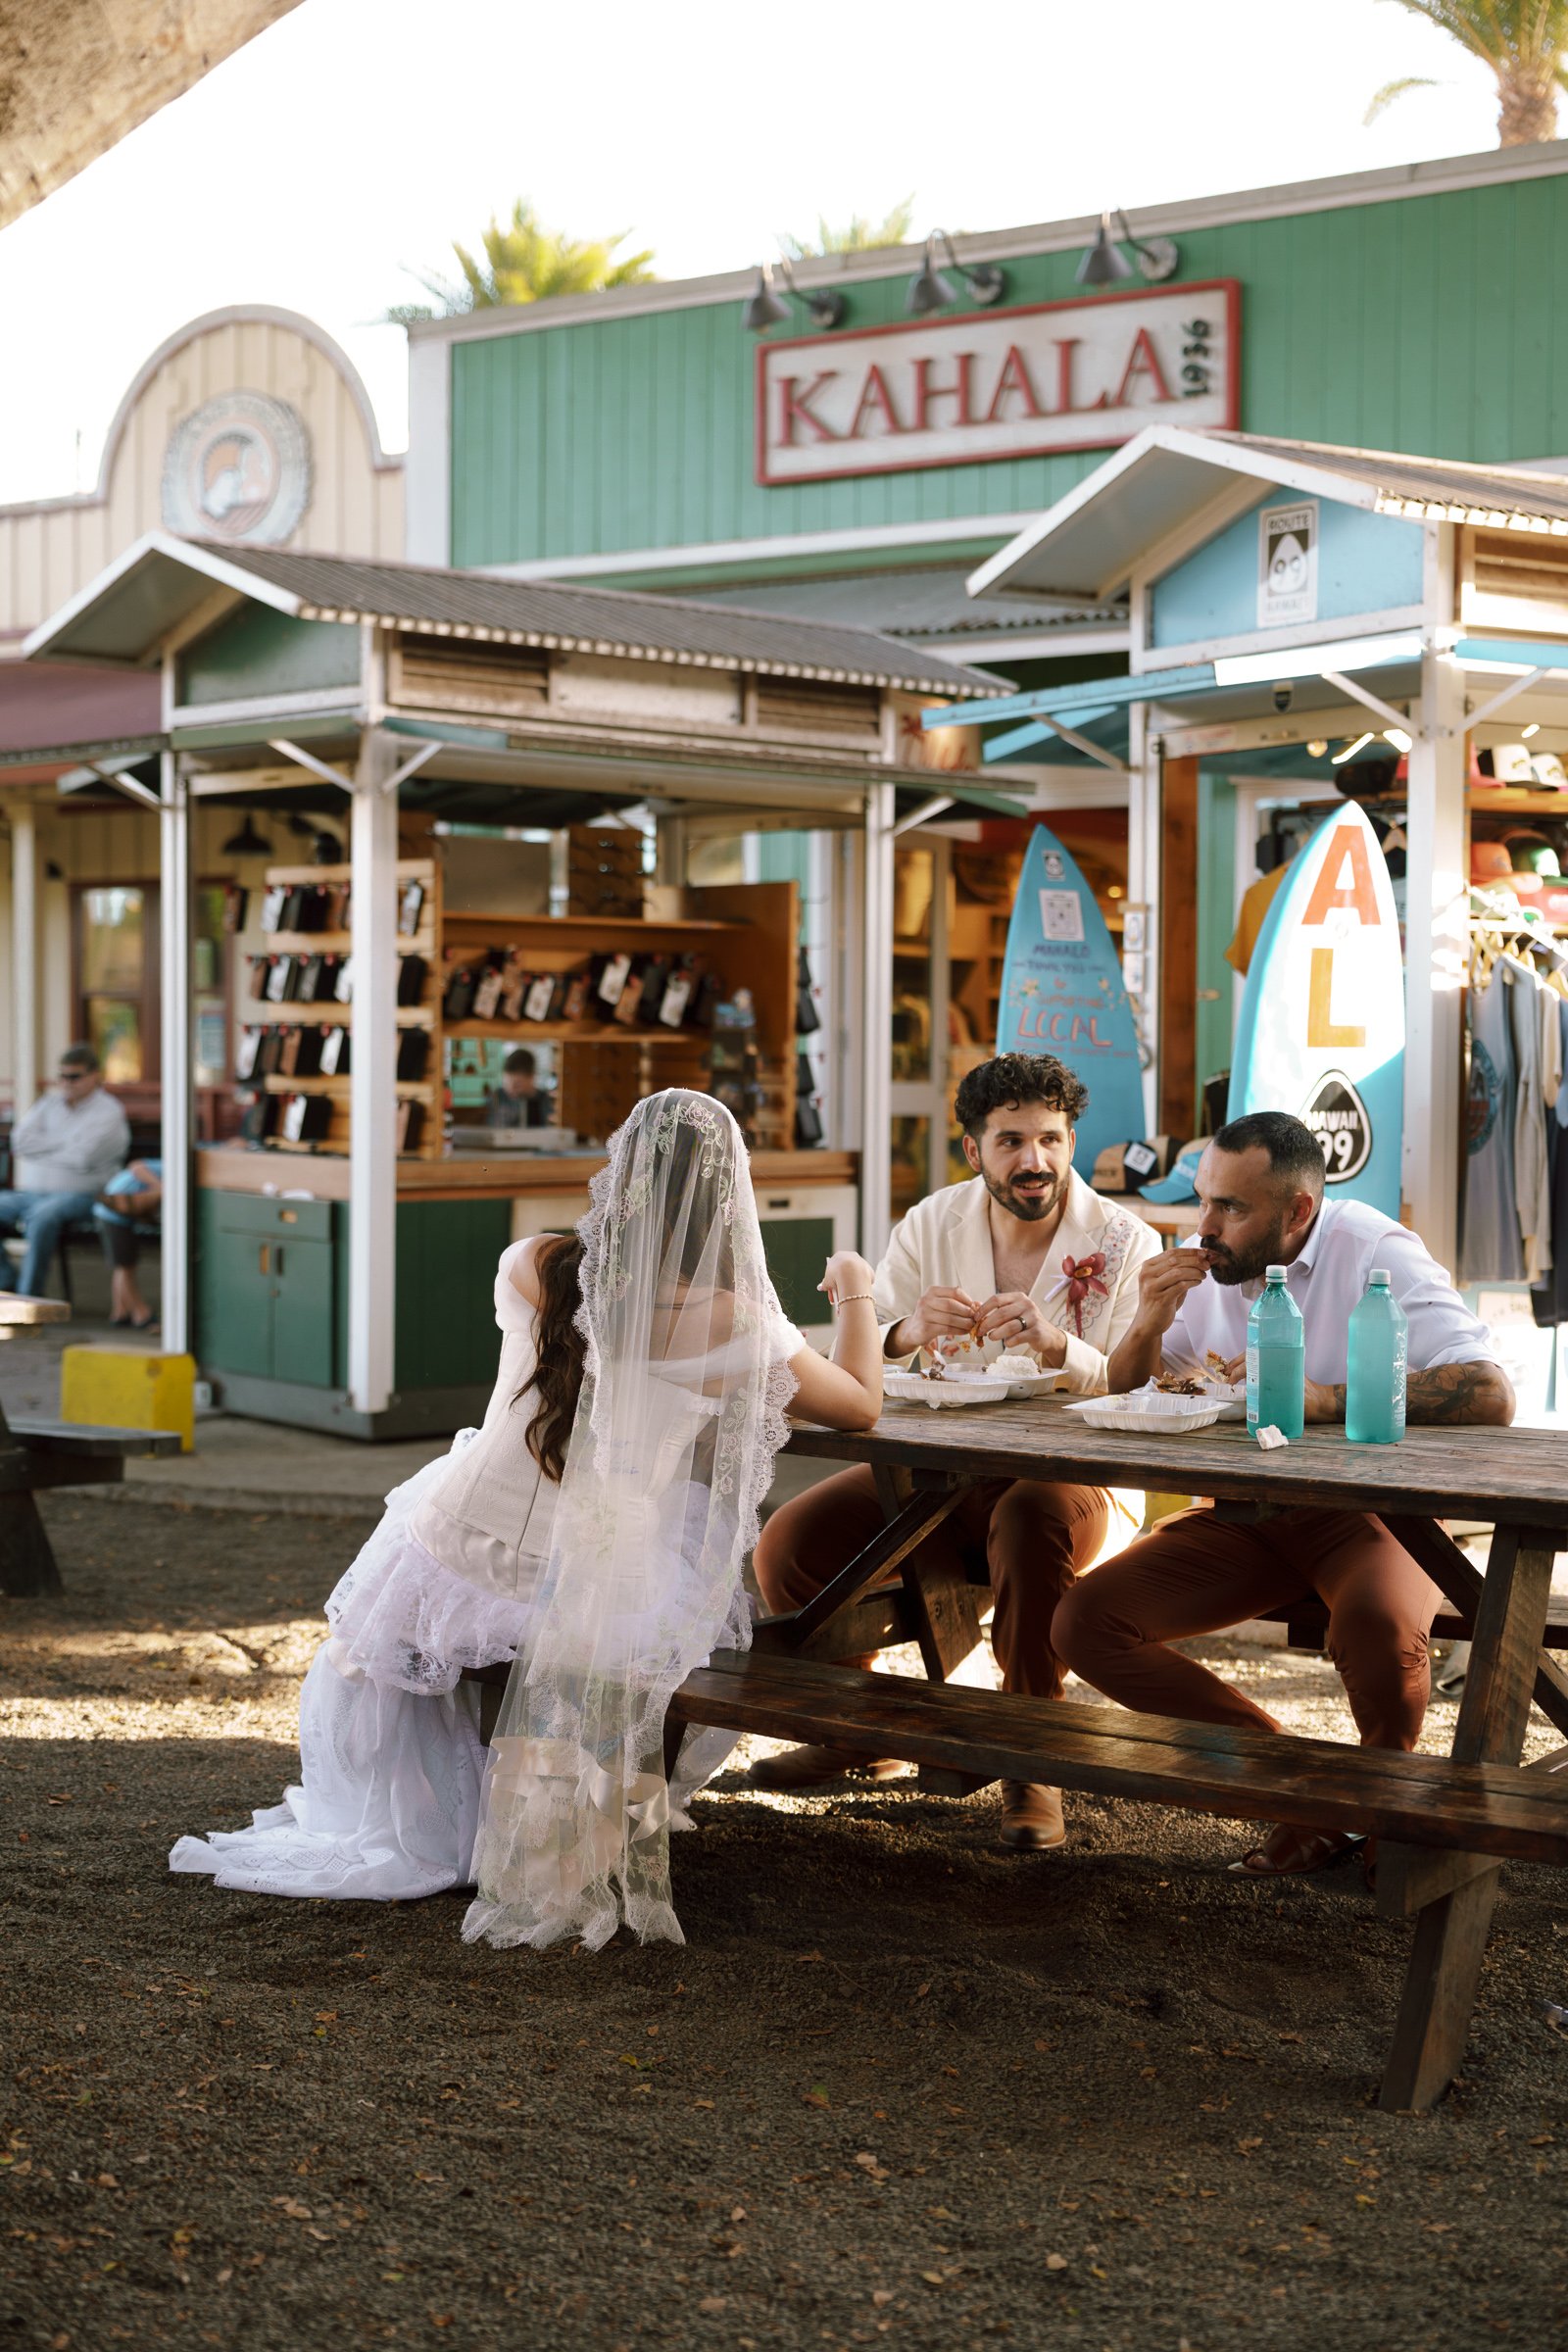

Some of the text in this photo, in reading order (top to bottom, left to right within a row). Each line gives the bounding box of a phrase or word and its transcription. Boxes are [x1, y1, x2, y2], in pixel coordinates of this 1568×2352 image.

[776, 327, 1178, 448] KAHALA
[1018, 1006, 1113, 1048] LOCAL
[1315, 1130, 1354, 1172] 99
